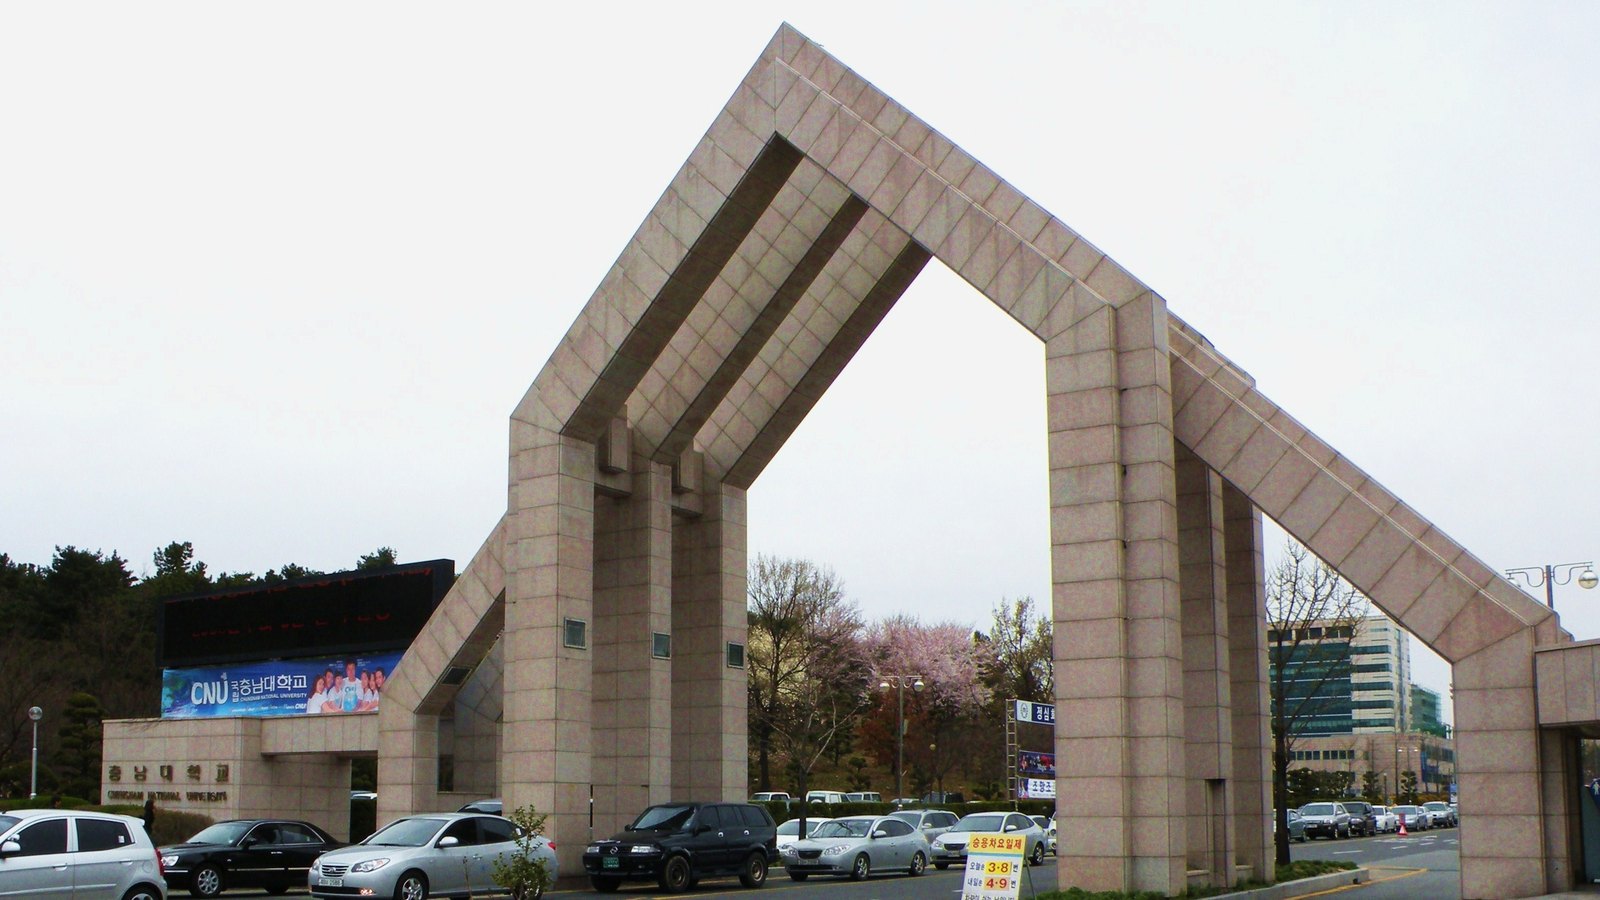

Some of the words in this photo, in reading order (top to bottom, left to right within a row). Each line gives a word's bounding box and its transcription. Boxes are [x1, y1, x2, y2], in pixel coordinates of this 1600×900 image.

[191, 678, 229, 705] CNU
[240, 674, 307, 696] 충남대학교
[186, 791, 228, 801] UNIVERSITY
[972, 838, 1022, 850] 승용차요일제
